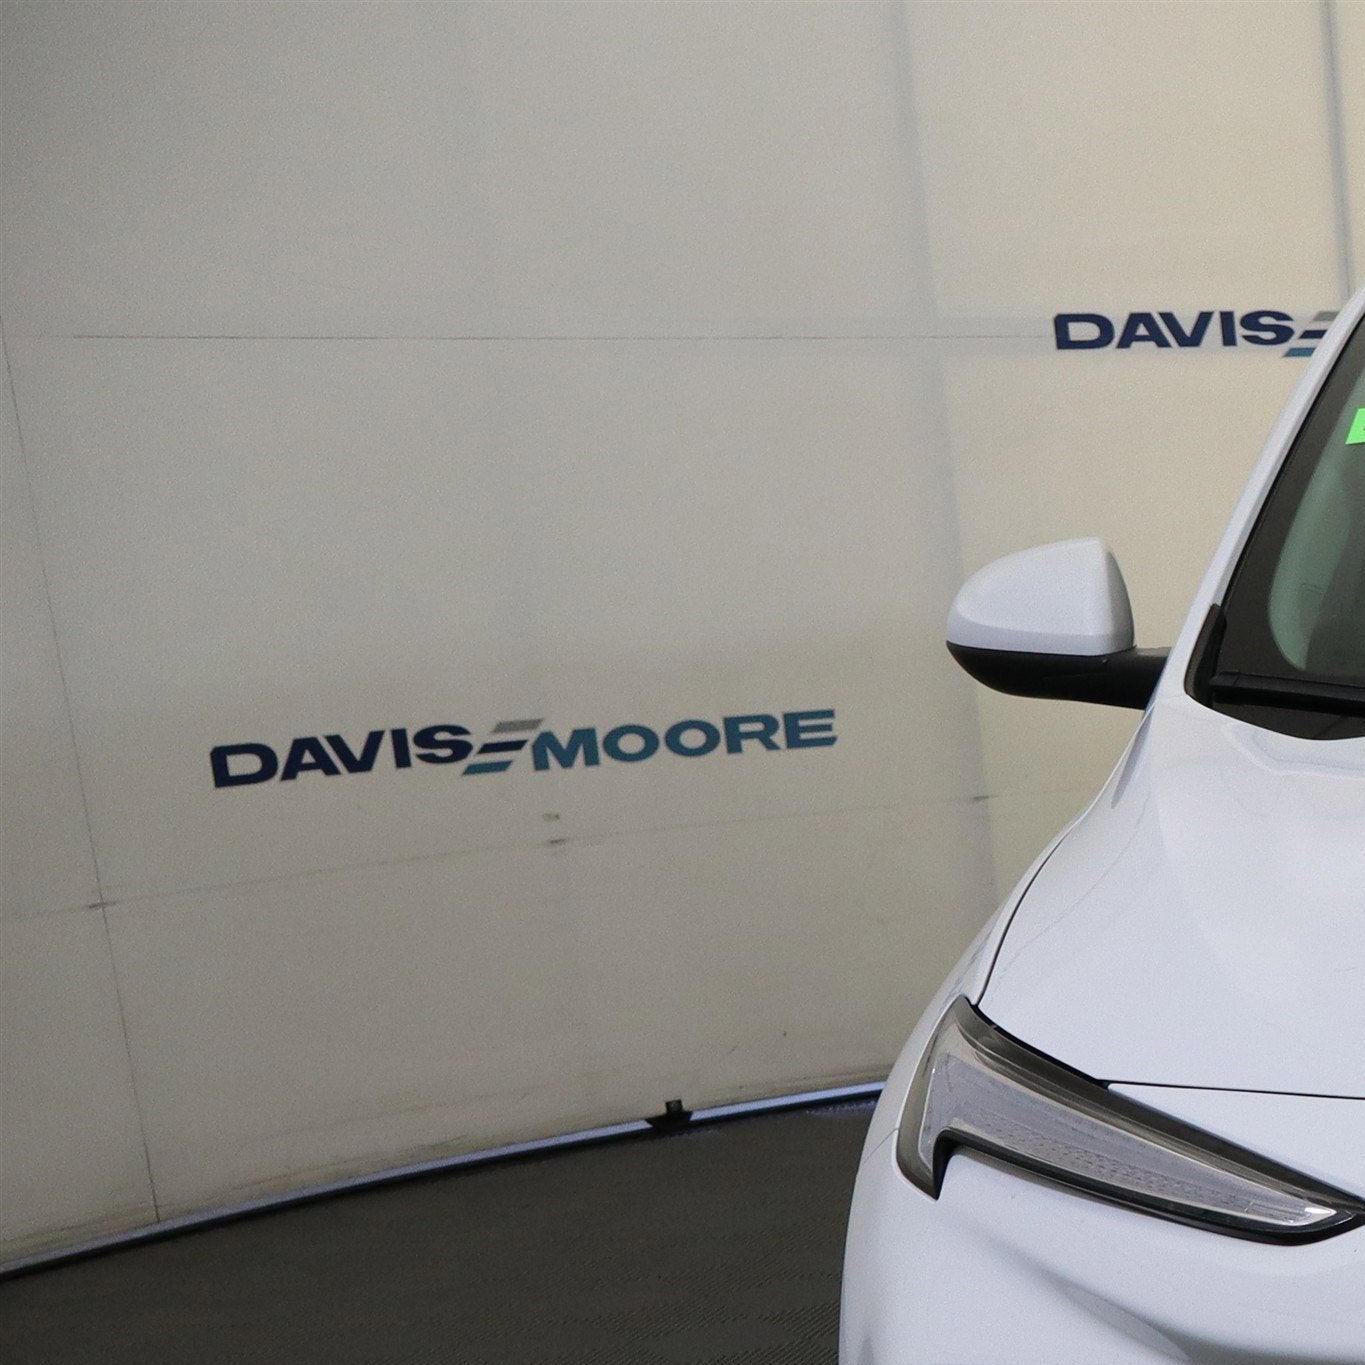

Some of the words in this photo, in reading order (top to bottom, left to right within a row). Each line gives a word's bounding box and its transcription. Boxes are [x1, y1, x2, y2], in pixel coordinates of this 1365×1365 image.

[1053, 310, 1295, 350] DAVIS
[209, 723, 475, 789] DAVIS
[530, 709, 839, 772] MOORE
